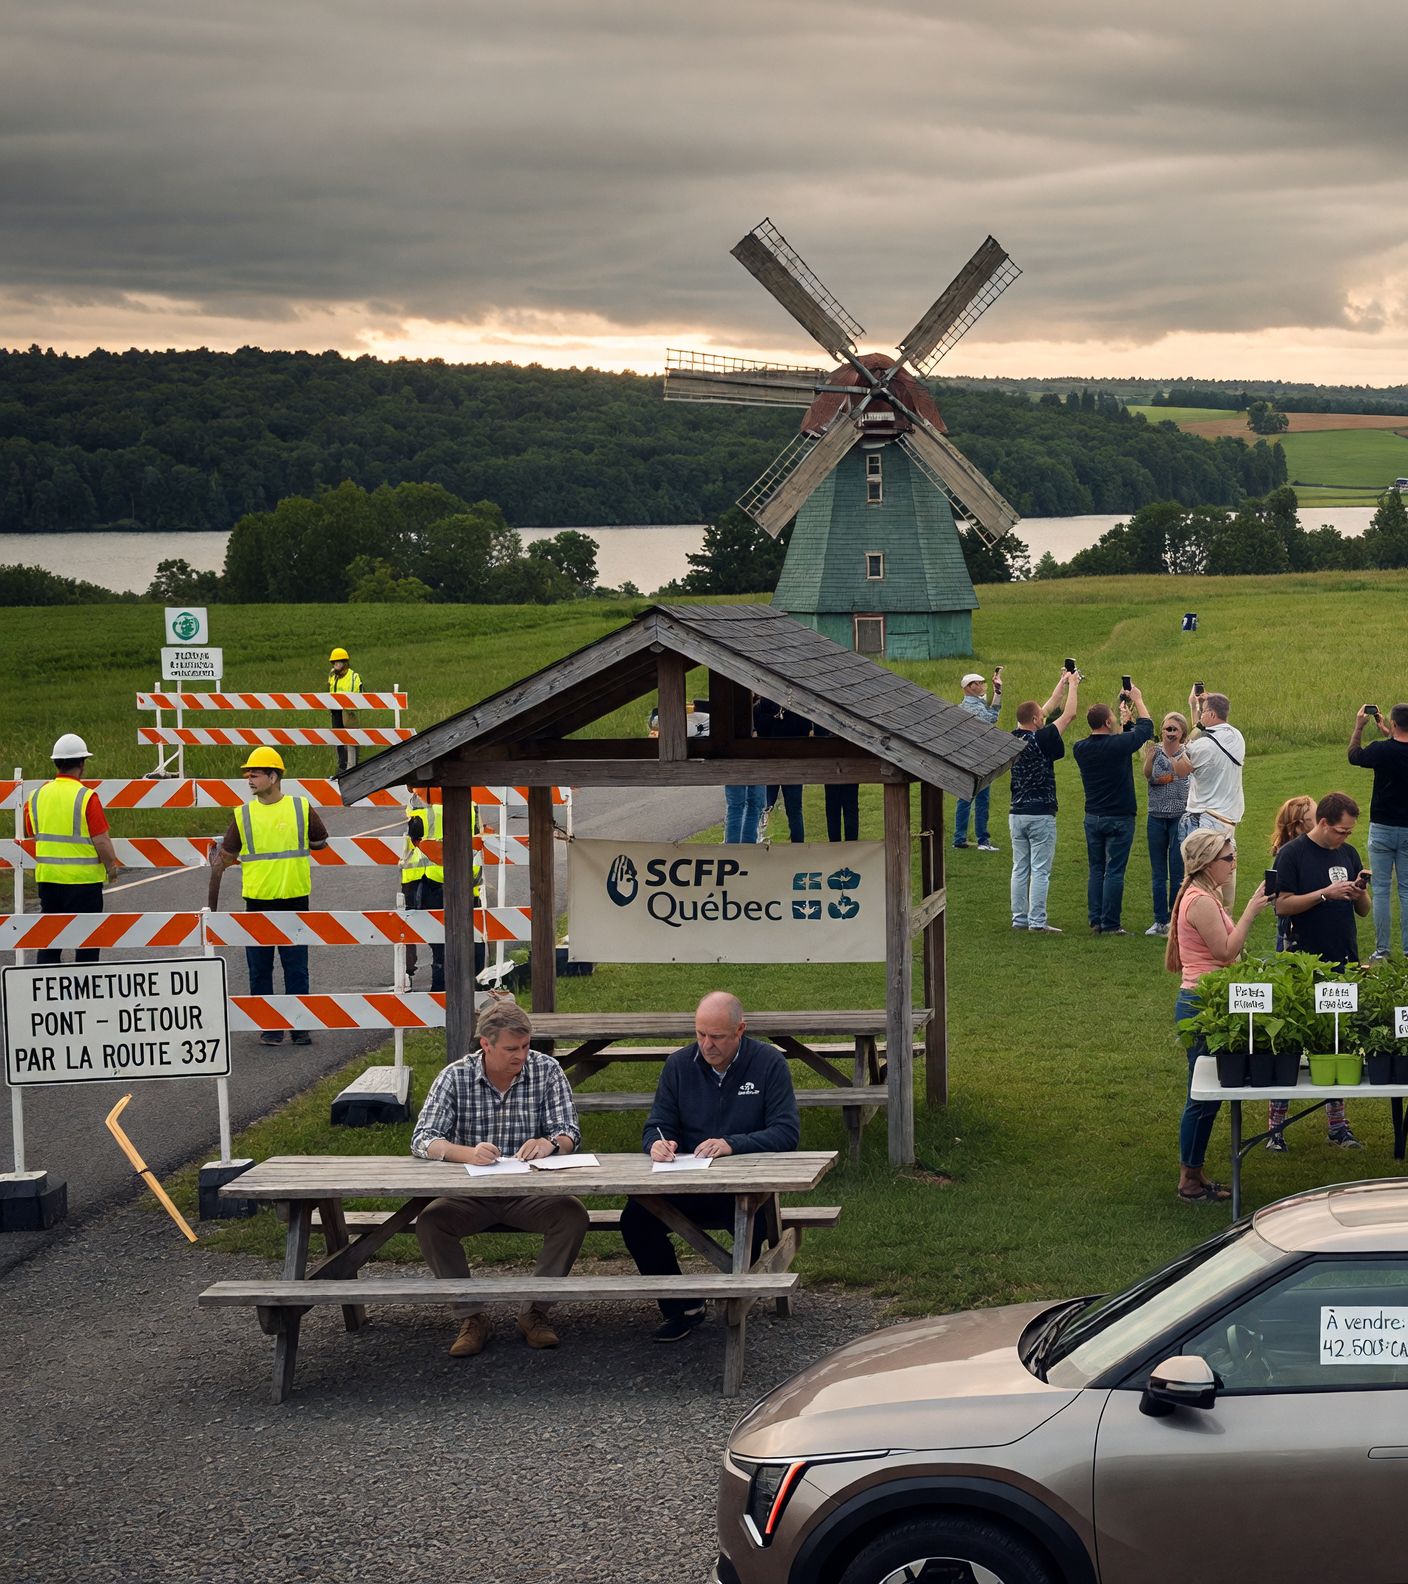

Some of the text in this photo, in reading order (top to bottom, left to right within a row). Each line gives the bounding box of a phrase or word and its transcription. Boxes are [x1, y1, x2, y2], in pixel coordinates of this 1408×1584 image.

[645, 859, 748, 887] SCFP-
[648, 891, 782, 927] Québec
[32, 971, 198, 1001] FERMETURE DU
[32, 1011, 86, 1036] PONT
[119, 1004, 203, 1032] DÉTOUR
[16, 1039, 220, 1072] PAR LA ROUTE 337
[1327, 1309, 1406, 1330] À vendre:
